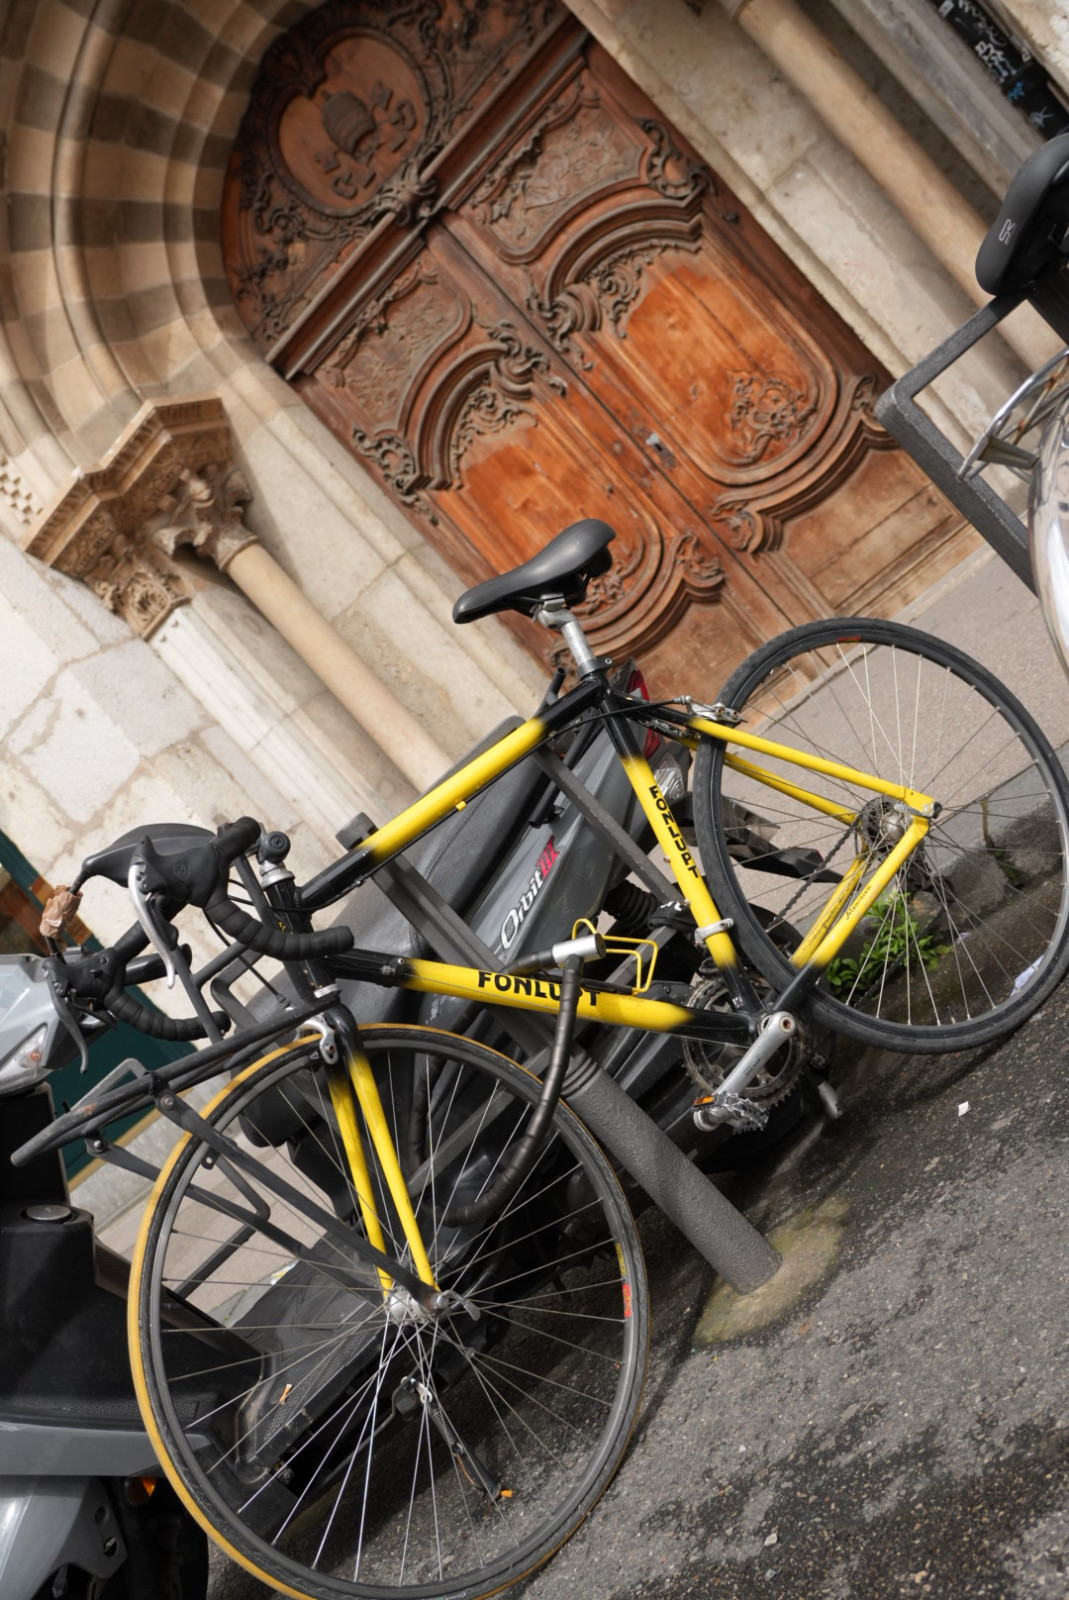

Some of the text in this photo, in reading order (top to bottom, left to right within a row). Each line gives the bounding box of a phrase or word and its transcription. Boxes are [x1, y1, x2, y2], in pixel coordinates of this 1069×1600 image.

[649, 785, 699, 878] FONLUPT
[501, 870, 544, 949] Orbit
[478, 971, 601, 1006] FONLUT
